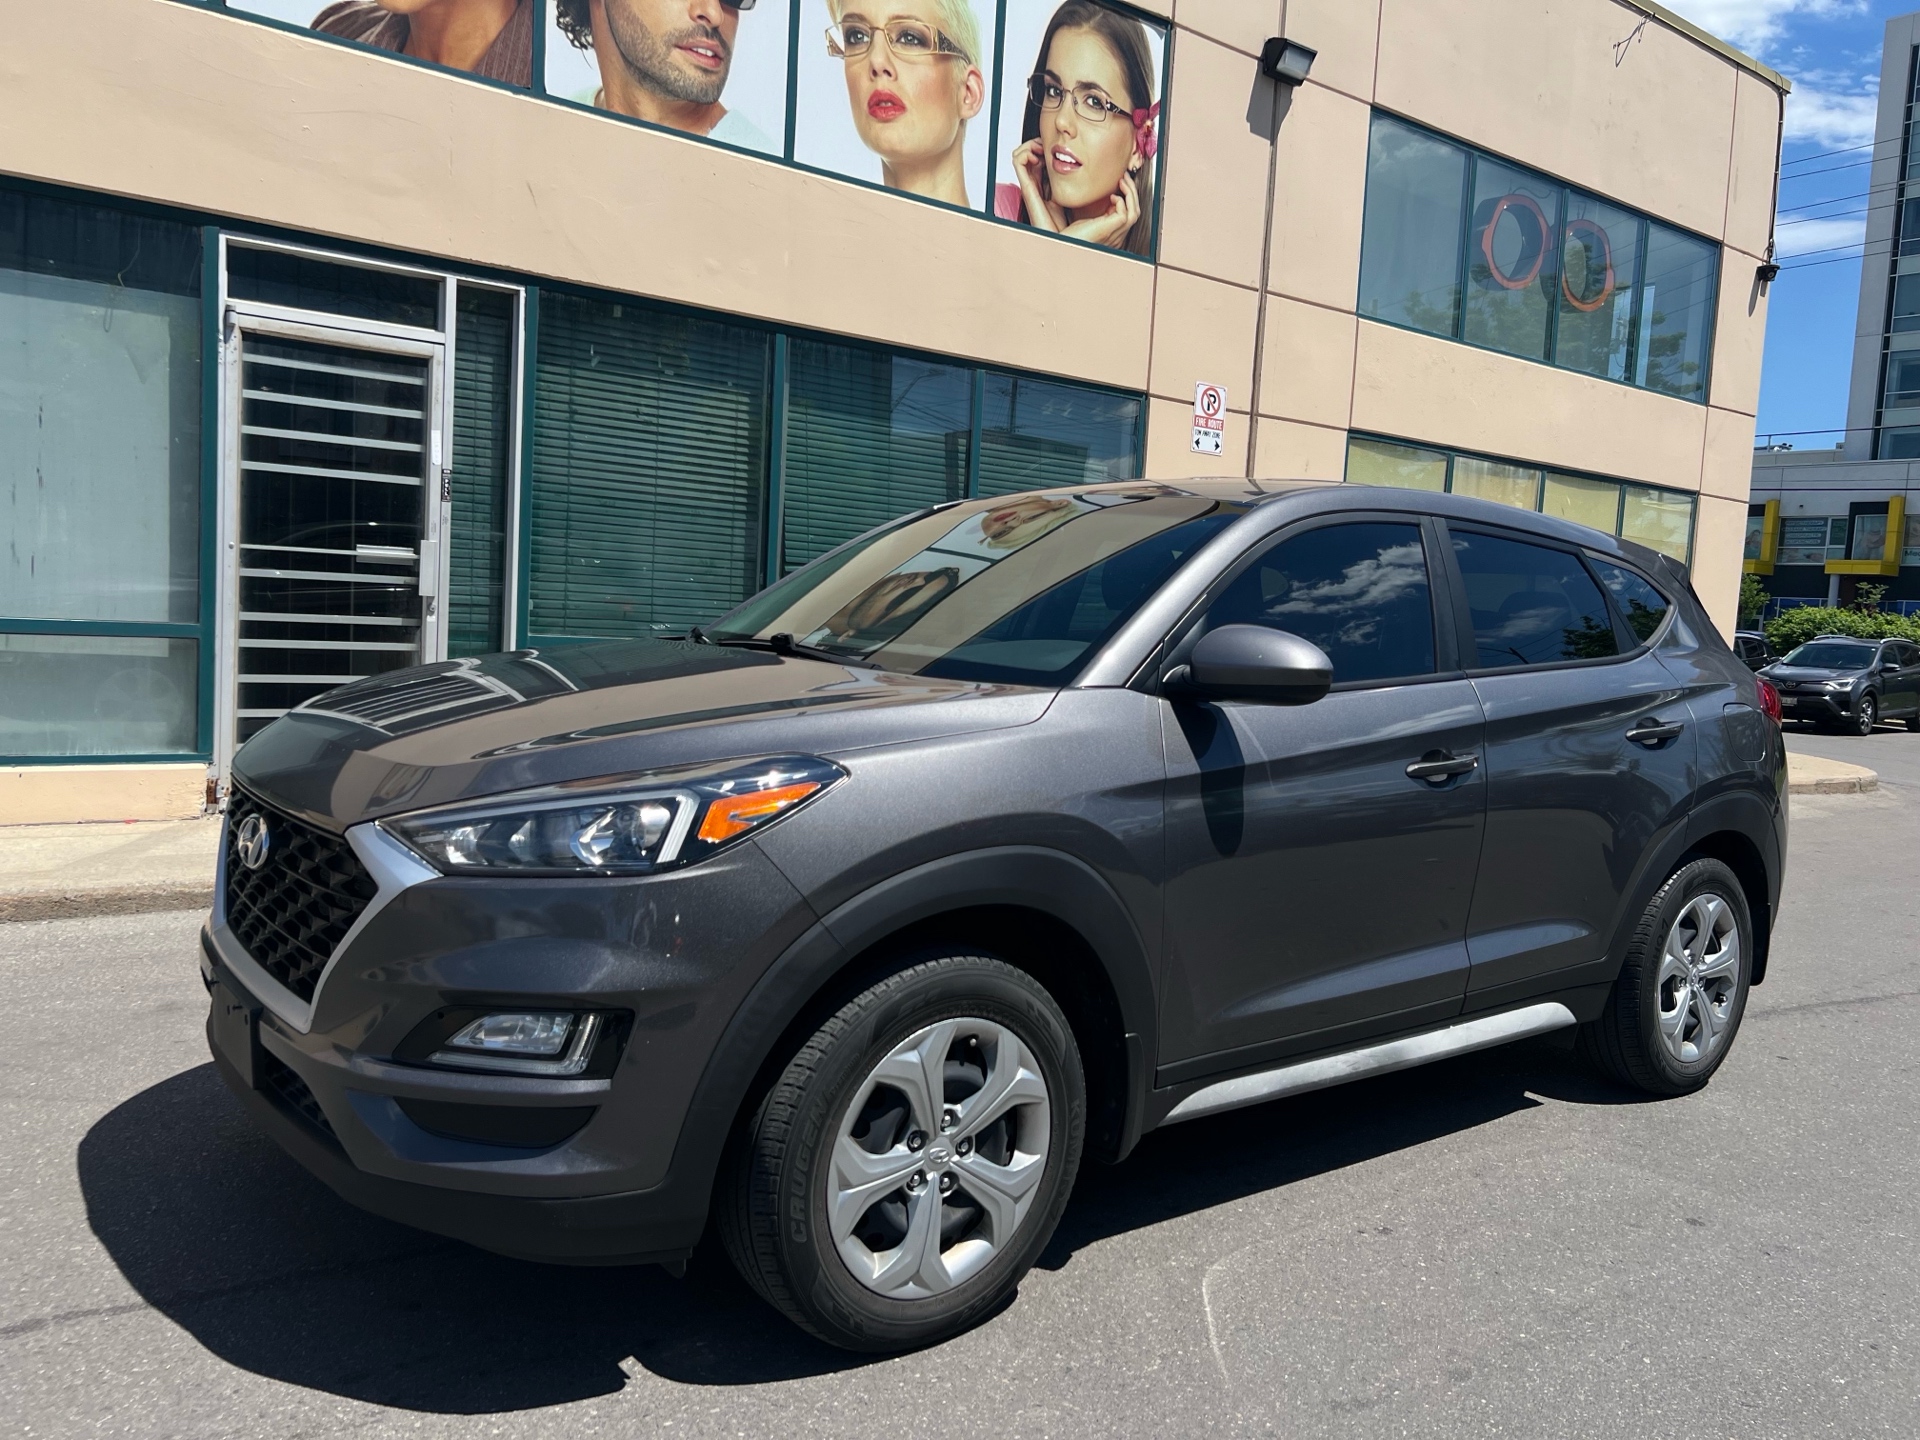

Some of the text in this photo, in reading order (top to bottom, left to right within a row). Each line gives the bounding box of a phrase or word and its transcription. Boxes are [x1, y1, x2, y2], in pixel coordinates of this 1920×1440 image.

[1195, 417, 1223, 430] FIRE ROUTE
[1202, 430, 1211, 438] AWAY
[790, 1089, 831, 1243] CRUGEN
